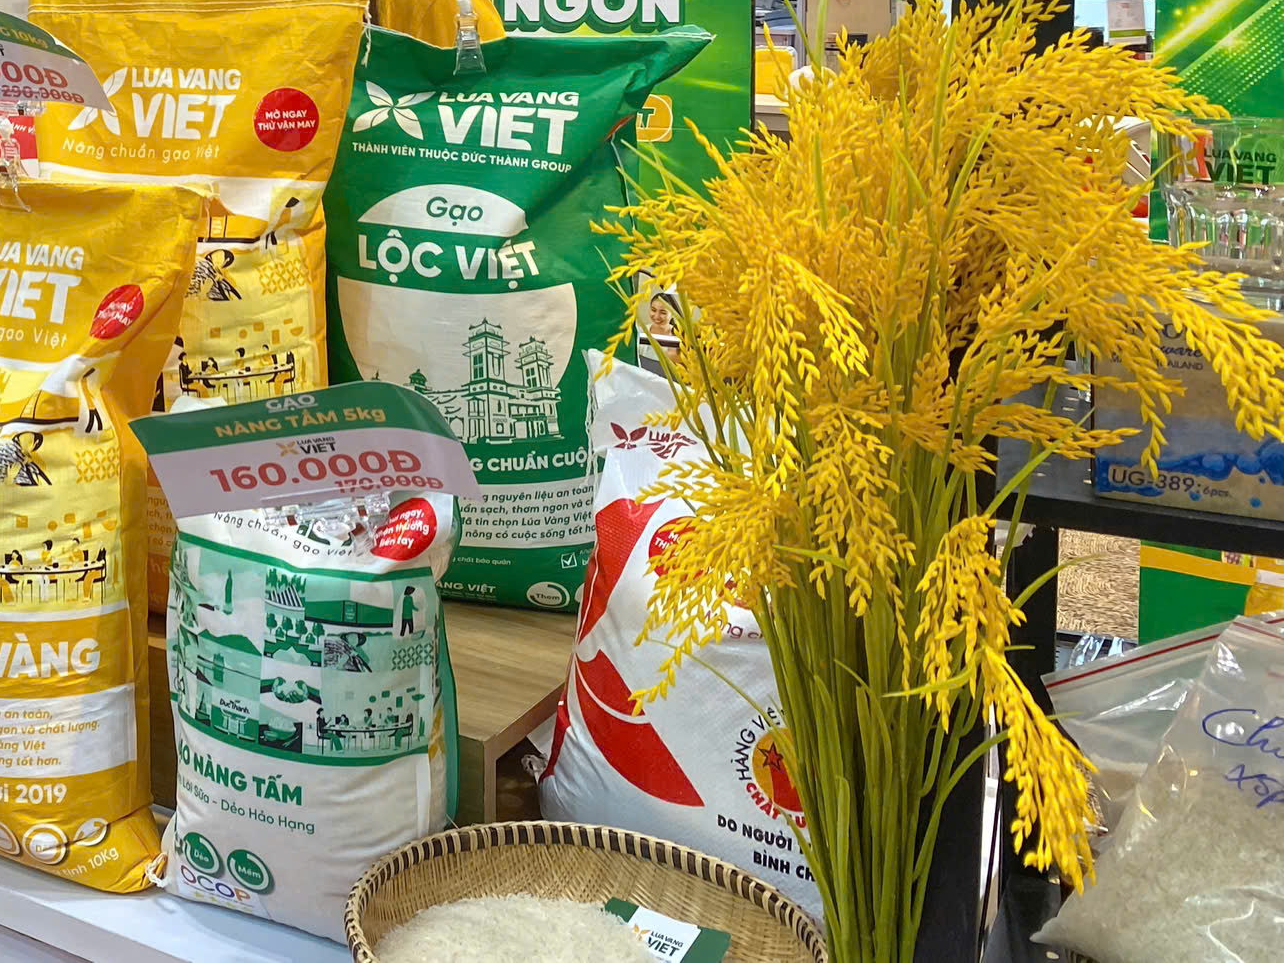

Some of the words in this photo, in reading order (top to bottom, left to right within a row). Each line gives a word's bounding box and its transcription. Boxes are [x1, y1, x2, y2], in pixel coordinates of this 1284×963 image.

[131, 67, 176, 89] LUA
[177, 68, 242, 91] VANG
[440, 91, 496, 107] LUA
[497, 91, 579, 107] VANG
[131, 93, 237, 140] VIET
[266, 109, 280, 120] MỞ
[282, 109, 308, 120] NGAY
[438, 105, 578, 155] VIET
[352, 140, 388, 154] THÀNH
[391, 143, 415, 157] VIÊN
[419, 145, 459, 162] THUỘC
[462, 147, 487, 164] ĐỨC
[489, 151, 529, 168] THÀNH
[531, 159, 572, 174] GROUP
[1234, 150, 1276, 163] VANG
[1207, 163, 1275, 185] VIET
[426, 197, 484, 226] Gạo
[26, 243, 84, 270] VANG
[358, 229, 444, 283] LỘC
[455, 240, 541, 289] VIỆT
[34, 330, 67, 349] Việt
[215, 416, 281, 438] NÀNG
[289, 406, 336, 431] TẤM
[343, 407, 387, 425] 5kg
[300, 441, 337, 455] VIET
[210, 450, 422, 492] 160.000Đ
[481, 504, 508, 515] sạch,
[512, 504, 539, 513] thơm
[543, 503, 568, 514] ngon
[572, 499, 582, 508] và
[15, 780, 67, 805] 2019
[193, 753, 247, 792] NÀNG
[253, 774, 302, 807] TẤM
[718, 814, 738, 834] DO
[89, 845, 119, 870] 10Kg
[181, 865, 250, 903] OCOP
[646, 936, 681, 959] VIET
